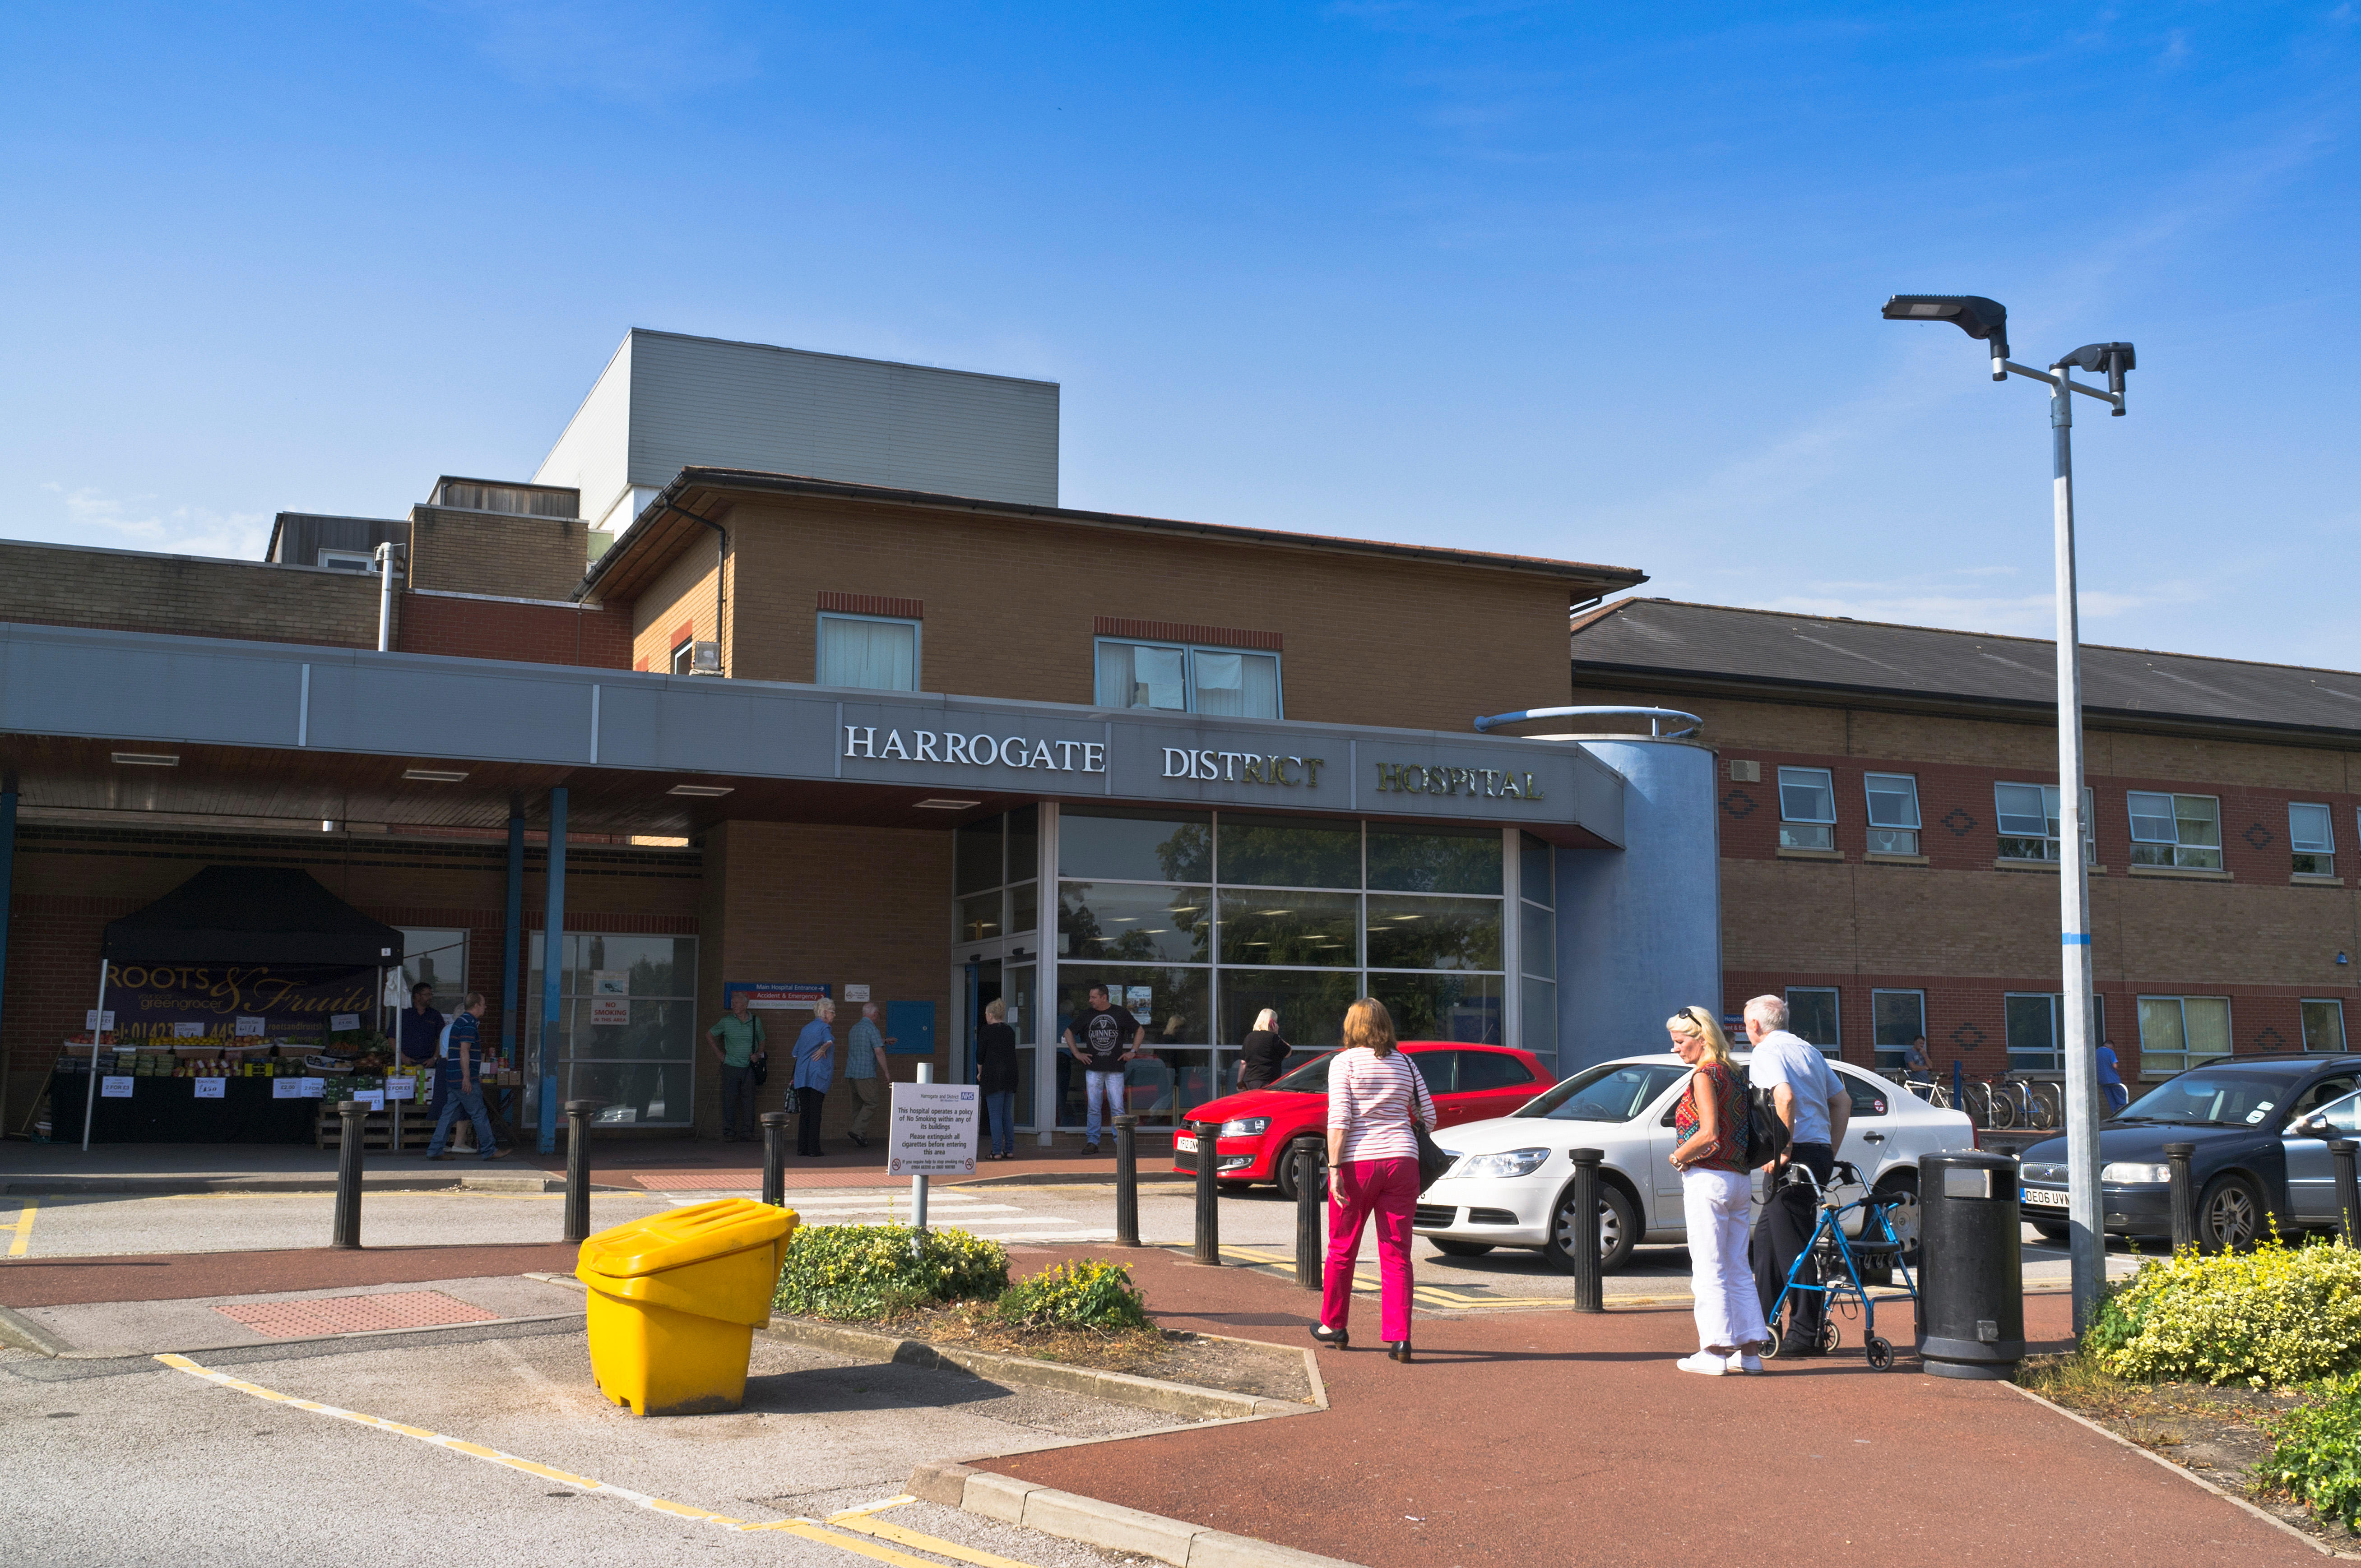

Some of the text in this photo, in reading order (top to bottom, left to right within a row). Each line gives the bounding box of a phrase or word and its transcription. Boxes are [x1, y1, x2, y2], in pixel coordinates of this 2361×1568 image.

[844, 726, 1545, 800] HARROGATE DISTRICT HOSPITAL
[106, 965, 376, 1014] ROOTS & Fruits
[140, 998, 223, 1011] greengrocer
[131, 1022, 174, 1039] 01423
[1088, 1030, 1119, 1038] GUINNESS
[928, 1123, 950, 1131] buildings
